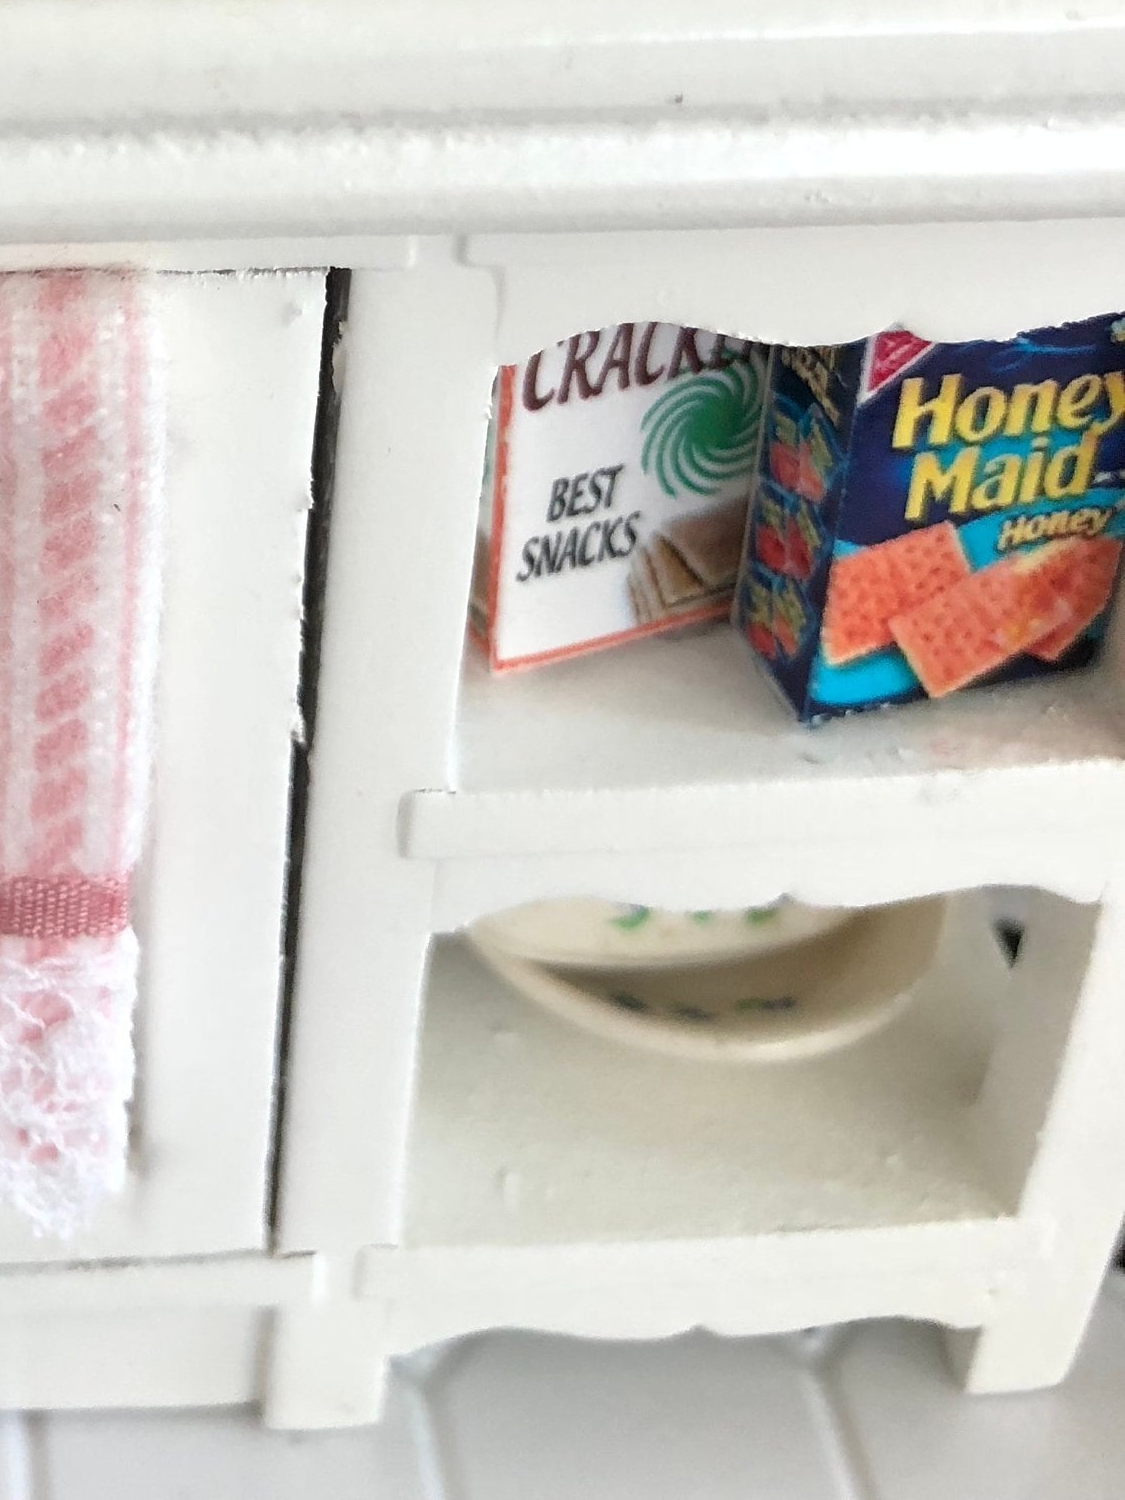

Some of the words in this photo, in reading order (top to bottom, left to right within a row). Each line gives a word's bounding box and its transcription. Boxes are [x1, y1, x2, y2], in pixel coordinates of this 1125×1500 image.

[891, 370, 1125, 449] Honey
[546, 463, 625, 523] BEST
[904, 428, 1099, 523] Maid
[515, 510, 642, 582] SNACKS
[996, 506, 1116, 551] Honey
